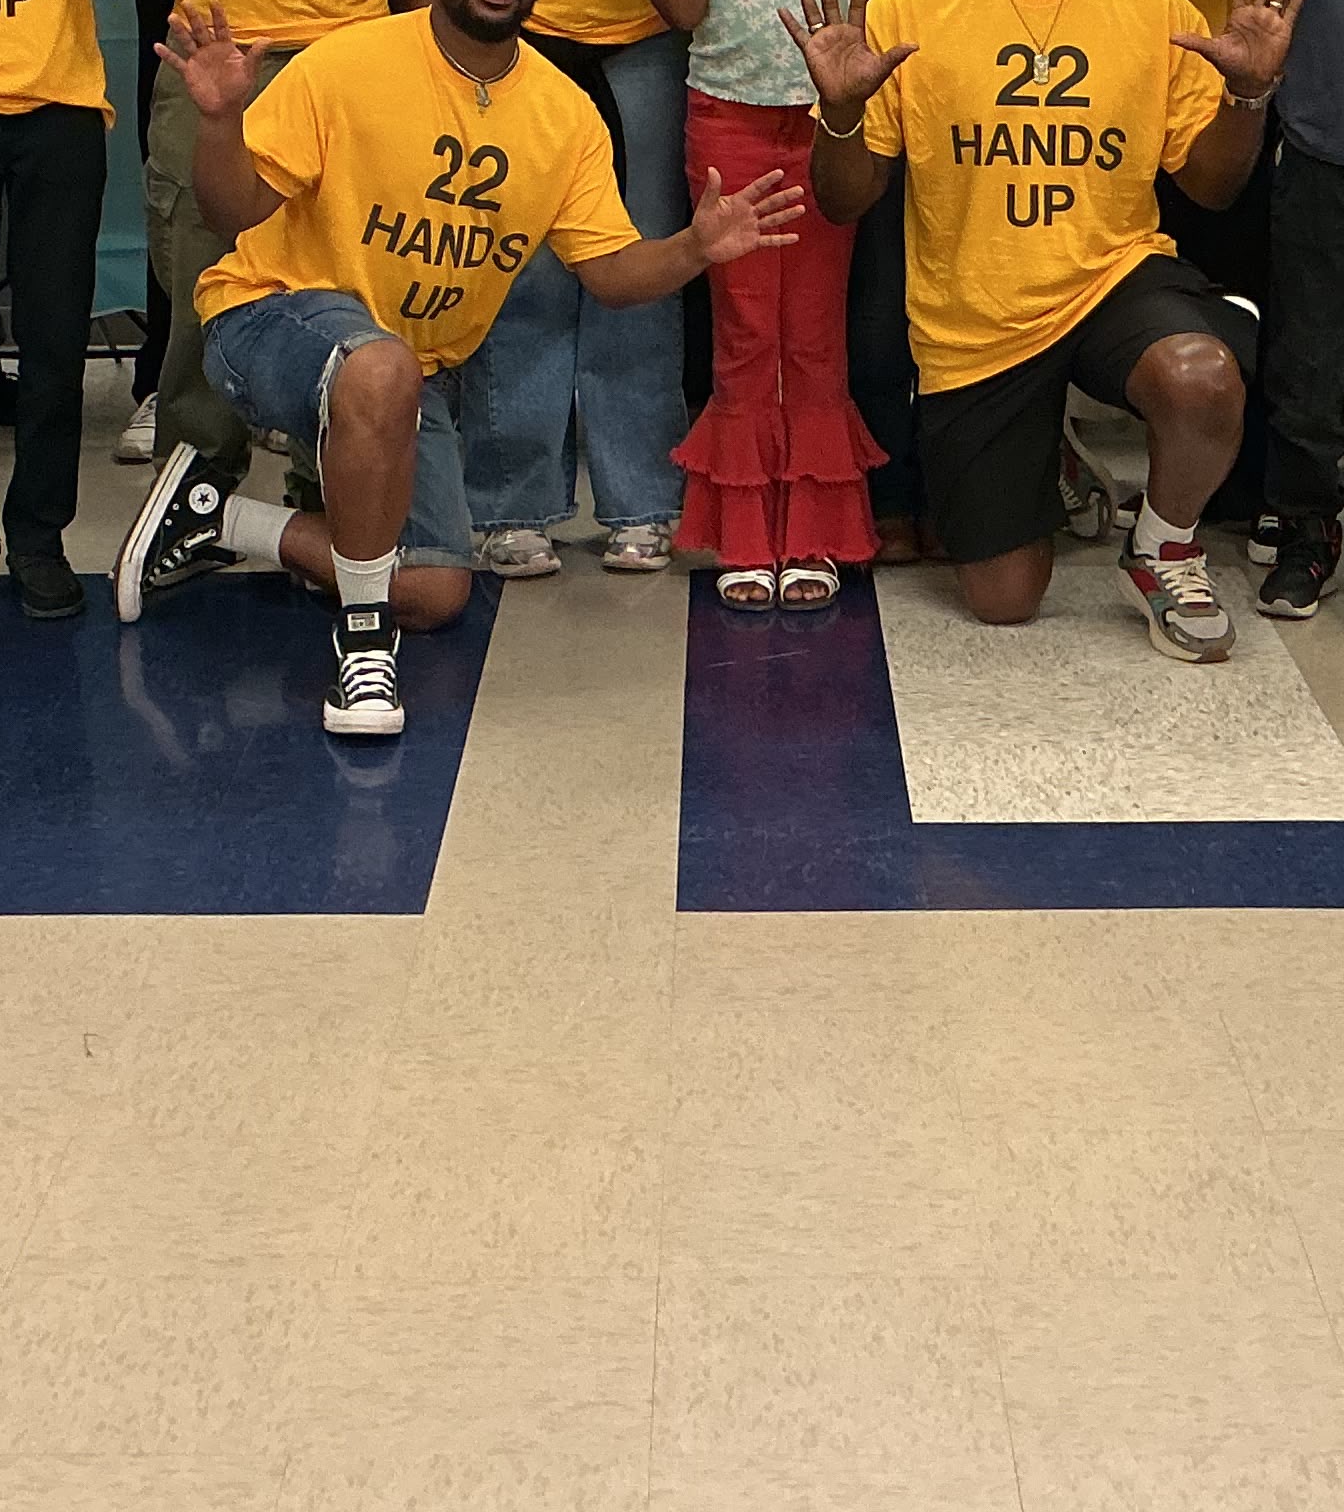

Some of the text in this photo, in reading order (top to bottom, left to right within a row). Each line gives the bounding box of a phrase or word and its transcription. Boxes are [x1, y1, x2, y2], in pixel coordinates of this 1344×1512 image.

[996, 43, 1090, 108] 22
[425, 134, 510, 213] 22
[951, 123, 1127, 171] HANDS
[1007, 184, 1075, 228] UP
[361, 203, 529, 273] HANDS
[400, 281, 465, 320] UP
